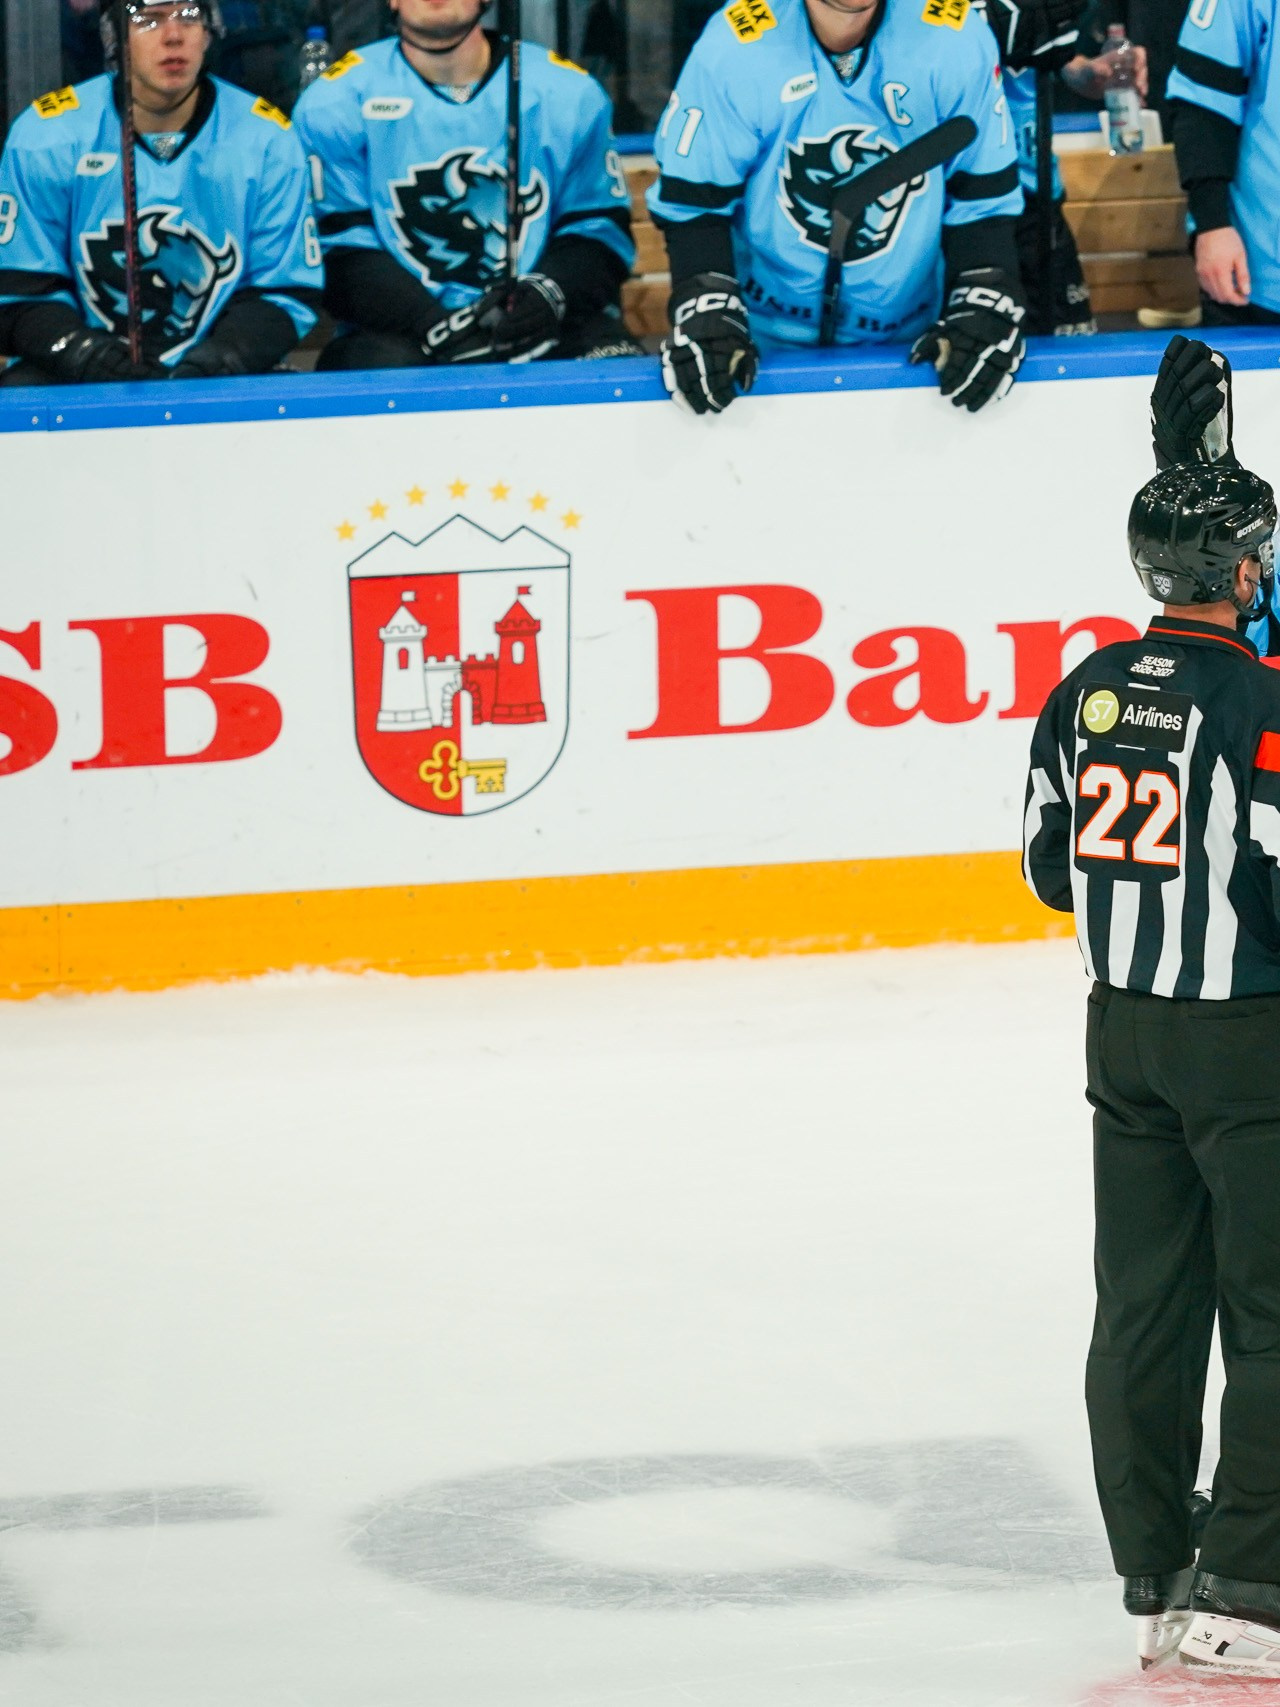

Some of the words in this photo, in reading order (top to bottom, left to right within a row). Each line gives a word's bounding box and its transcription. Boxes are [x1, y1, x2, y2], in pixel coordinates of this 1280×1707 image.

[728, 7, 756, 37] LINE
[747, 0, 769, 24] AX
[881, 81, 914, 128] C
[949, 286, 1026, 324] CCM
[1140, 655, 1176, 669] SEASON
[1087, 697, 1116, 724] S7
[1121, 703, 1184, 732] Airlines
[1076, 762, 1181, 867] 22
